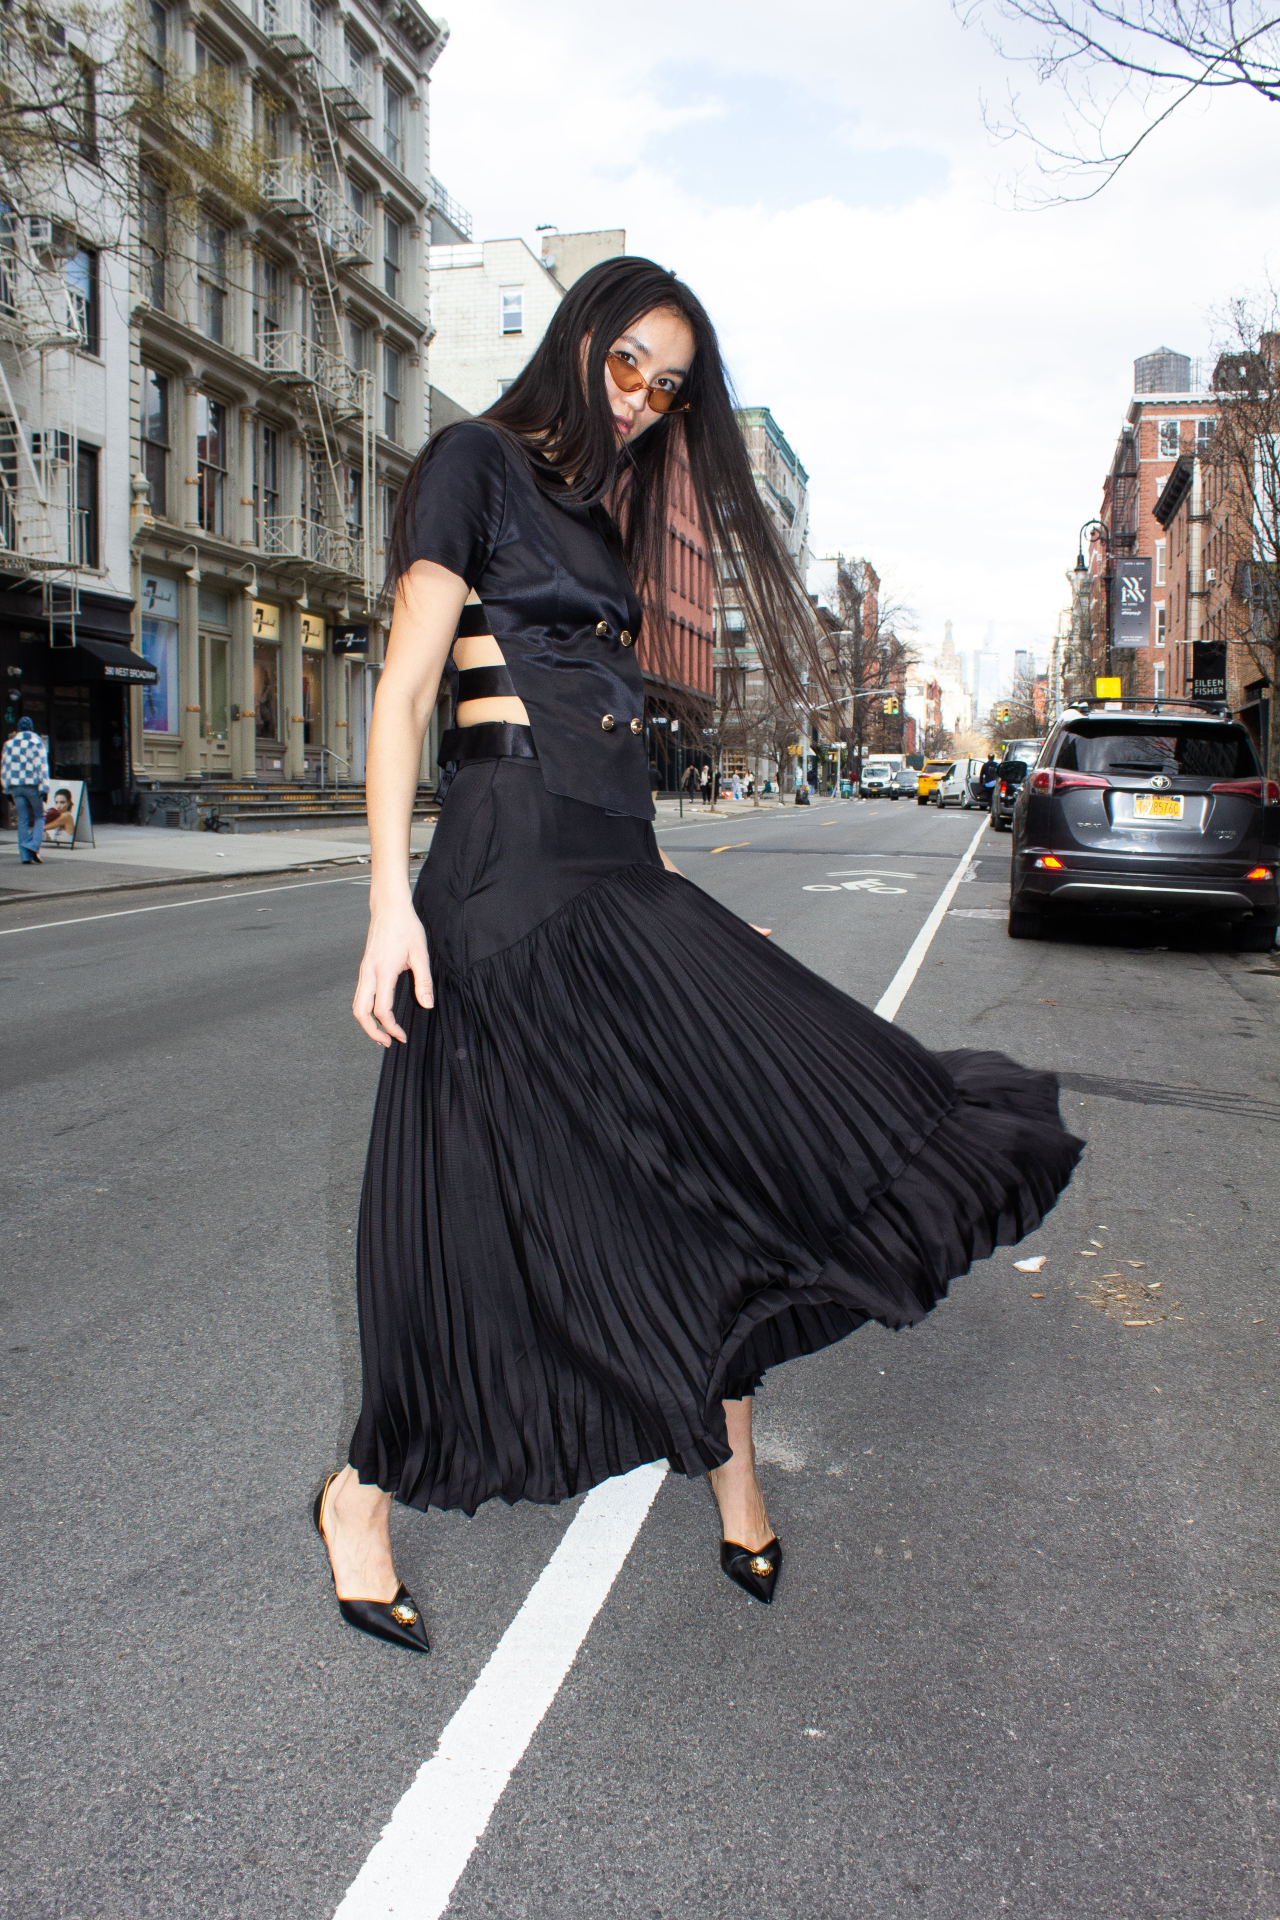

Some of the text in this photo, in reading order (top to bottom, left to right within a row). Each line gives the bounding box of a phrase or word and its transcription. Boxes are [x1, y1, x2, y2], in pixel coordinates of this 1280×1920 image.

[115, 667, 129, 677] WEST
[129, 668, 157, 680] BROADWAY
[1194, 679, 1224, 687] EILEEN
[1194, 687, 1224, 695] FISHER
